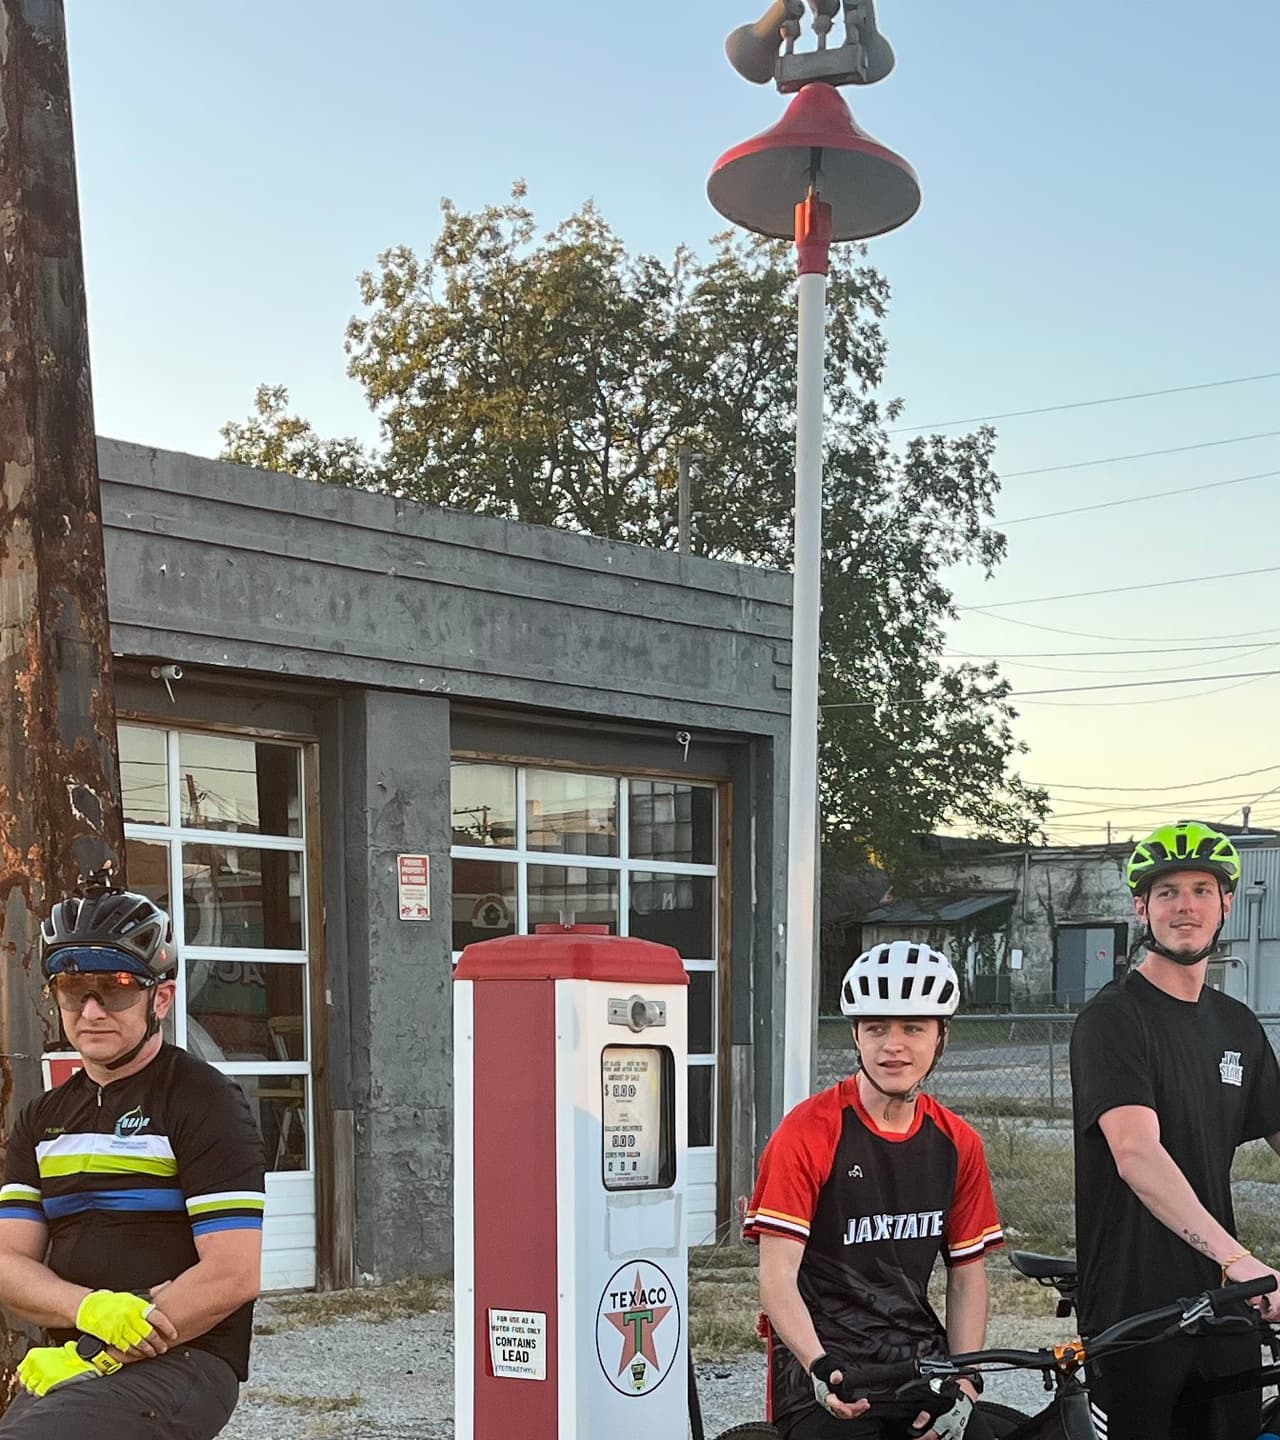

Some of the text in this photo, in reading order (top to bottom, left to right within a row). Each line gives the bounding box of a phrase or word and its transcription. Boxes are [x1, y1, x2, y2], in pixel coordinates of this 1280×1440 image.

[610, 1288, 667, 1309] TEXACO
[623, 1309, 654, 1354] T
[496, 1337, 536, 1349] CONTAINS
[502, 1350, 529, 1363] LEAD
